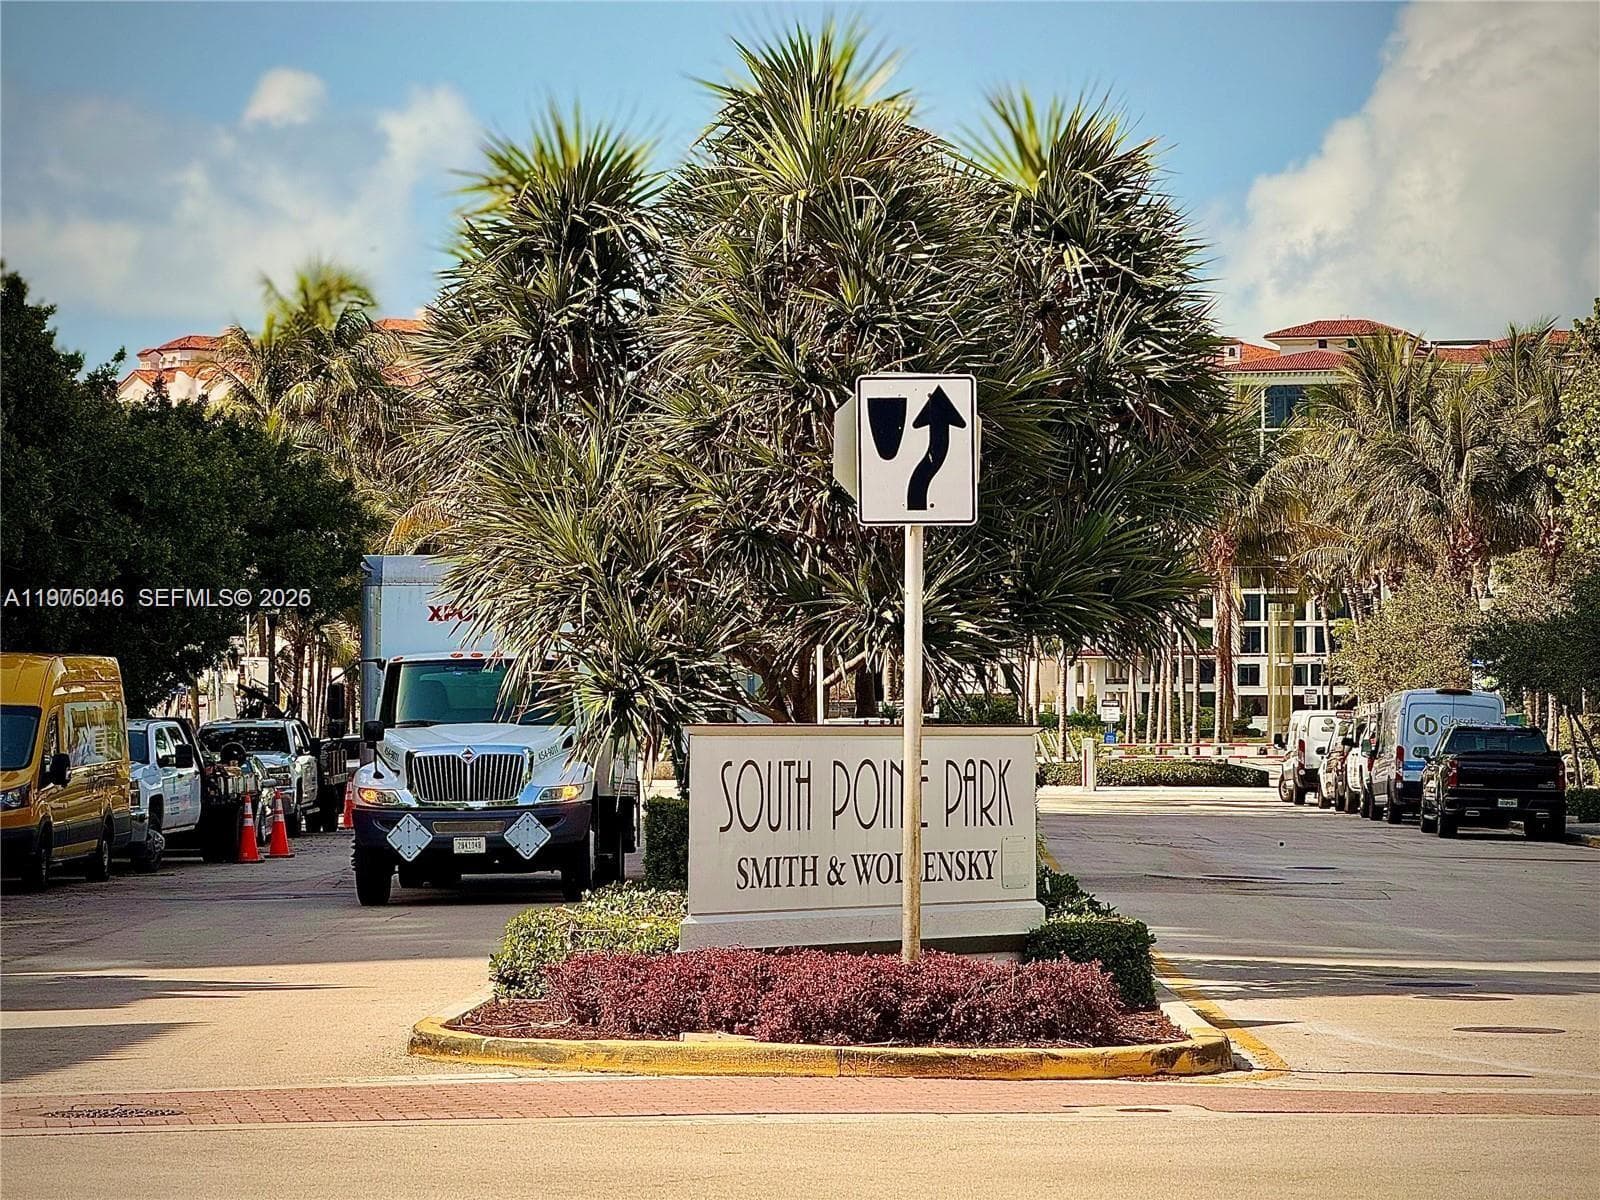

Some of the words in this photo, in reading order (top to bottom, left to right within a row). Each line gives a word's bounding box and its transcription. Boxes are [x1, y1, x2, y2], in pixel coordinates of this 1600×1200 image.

[719, 759, 812, 833] SOUTH
[832, 758, 929, 830] POINE
[945, 757, 1015, 827] PARK
[736, 855, 819, 890] SMITH
[827, 855, 847, 886] &
[851, 849, 998, 885] WOLENSKY
